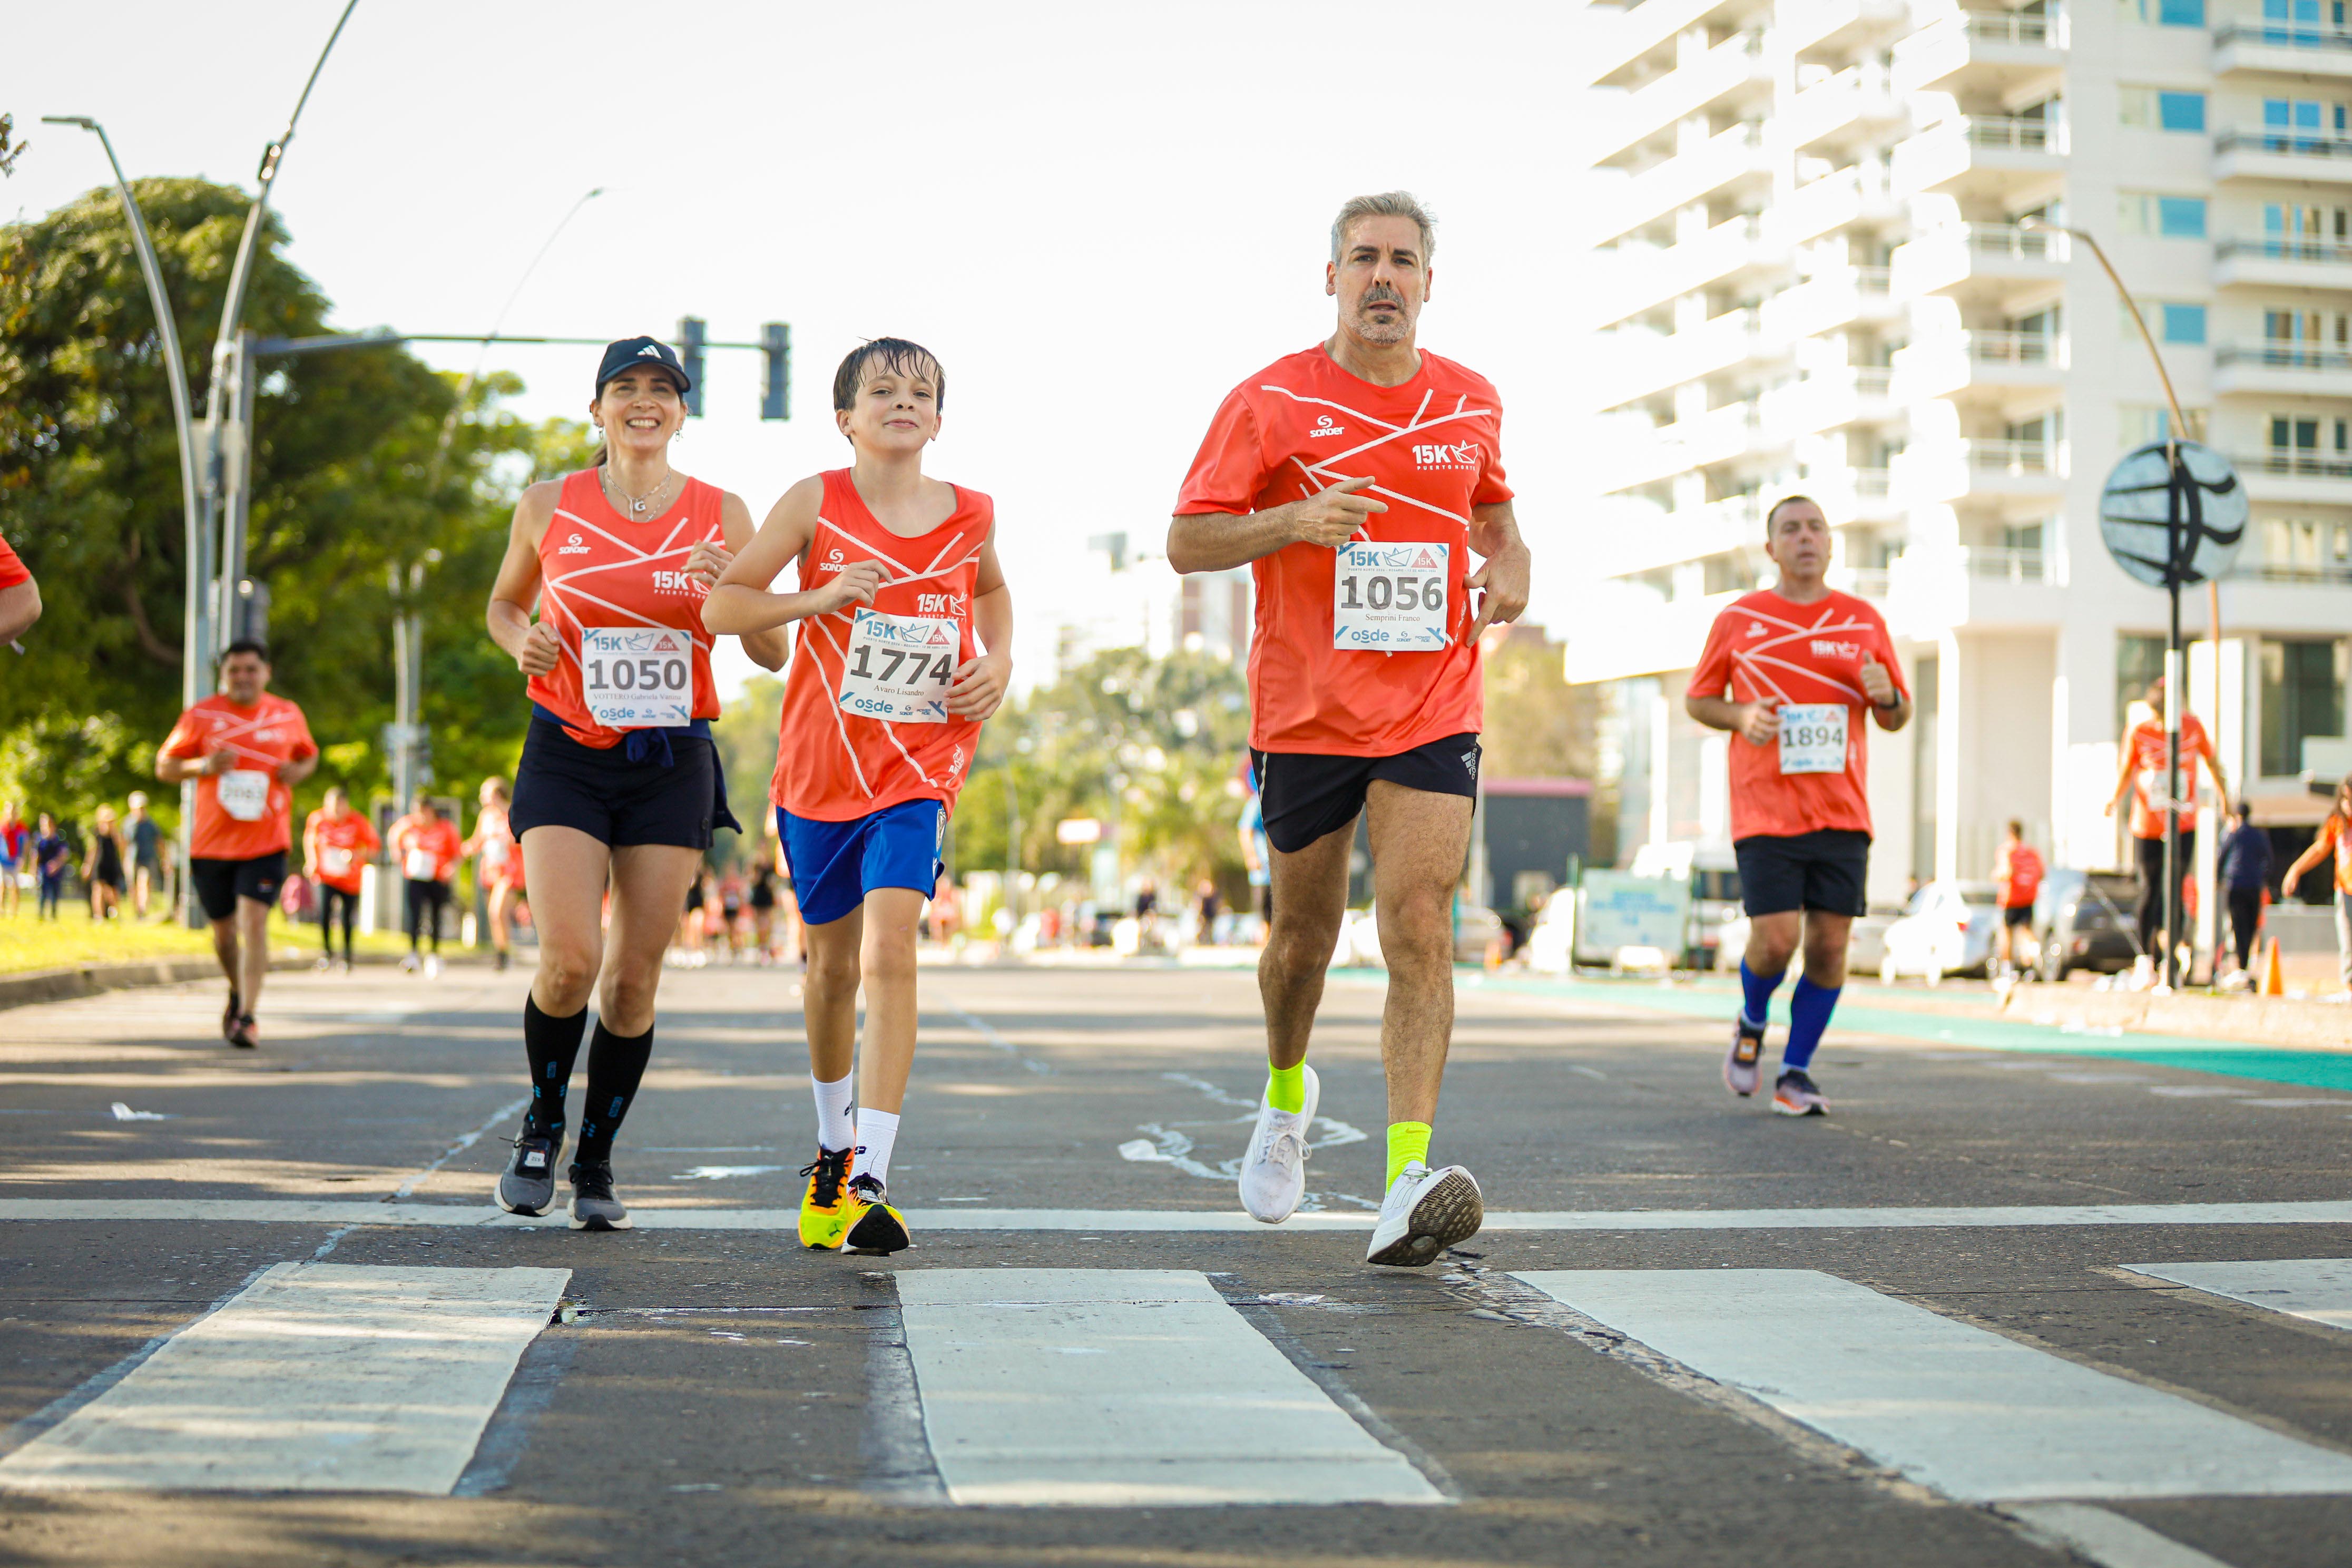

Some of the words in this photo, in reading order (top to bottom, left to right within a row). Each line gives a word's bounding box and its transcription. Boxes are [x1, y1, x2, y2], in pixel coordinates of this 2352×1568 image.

[1412, 445, 1451, 464] 15K
[634, 500, 646, 512] G
[1349, 551, 1379, 566] 15K
[652, 571, 689, 590] 15K
[1341, 576, 1443, 611] 1056
[917, 593, 948, 612] 15K
[1366, 614, 1396, 622] Semprini
[866, 620, 897, 640] 15K
[1351, 629, 1389, 643] osde
[594, 636, 622, 650] 15K
[660, 641, 674, 649] 15K
[850, 644, 952, 685] 1774
[589, 659, 687, 690] 1050
[874, 685, 895, 694] Avaro
[897, 688, 924, 696] Lisandro
[600, 707, 635, 720] osde
[855, 699, 893, 713] osde
[1783, 727, 1843, 748] 1894
